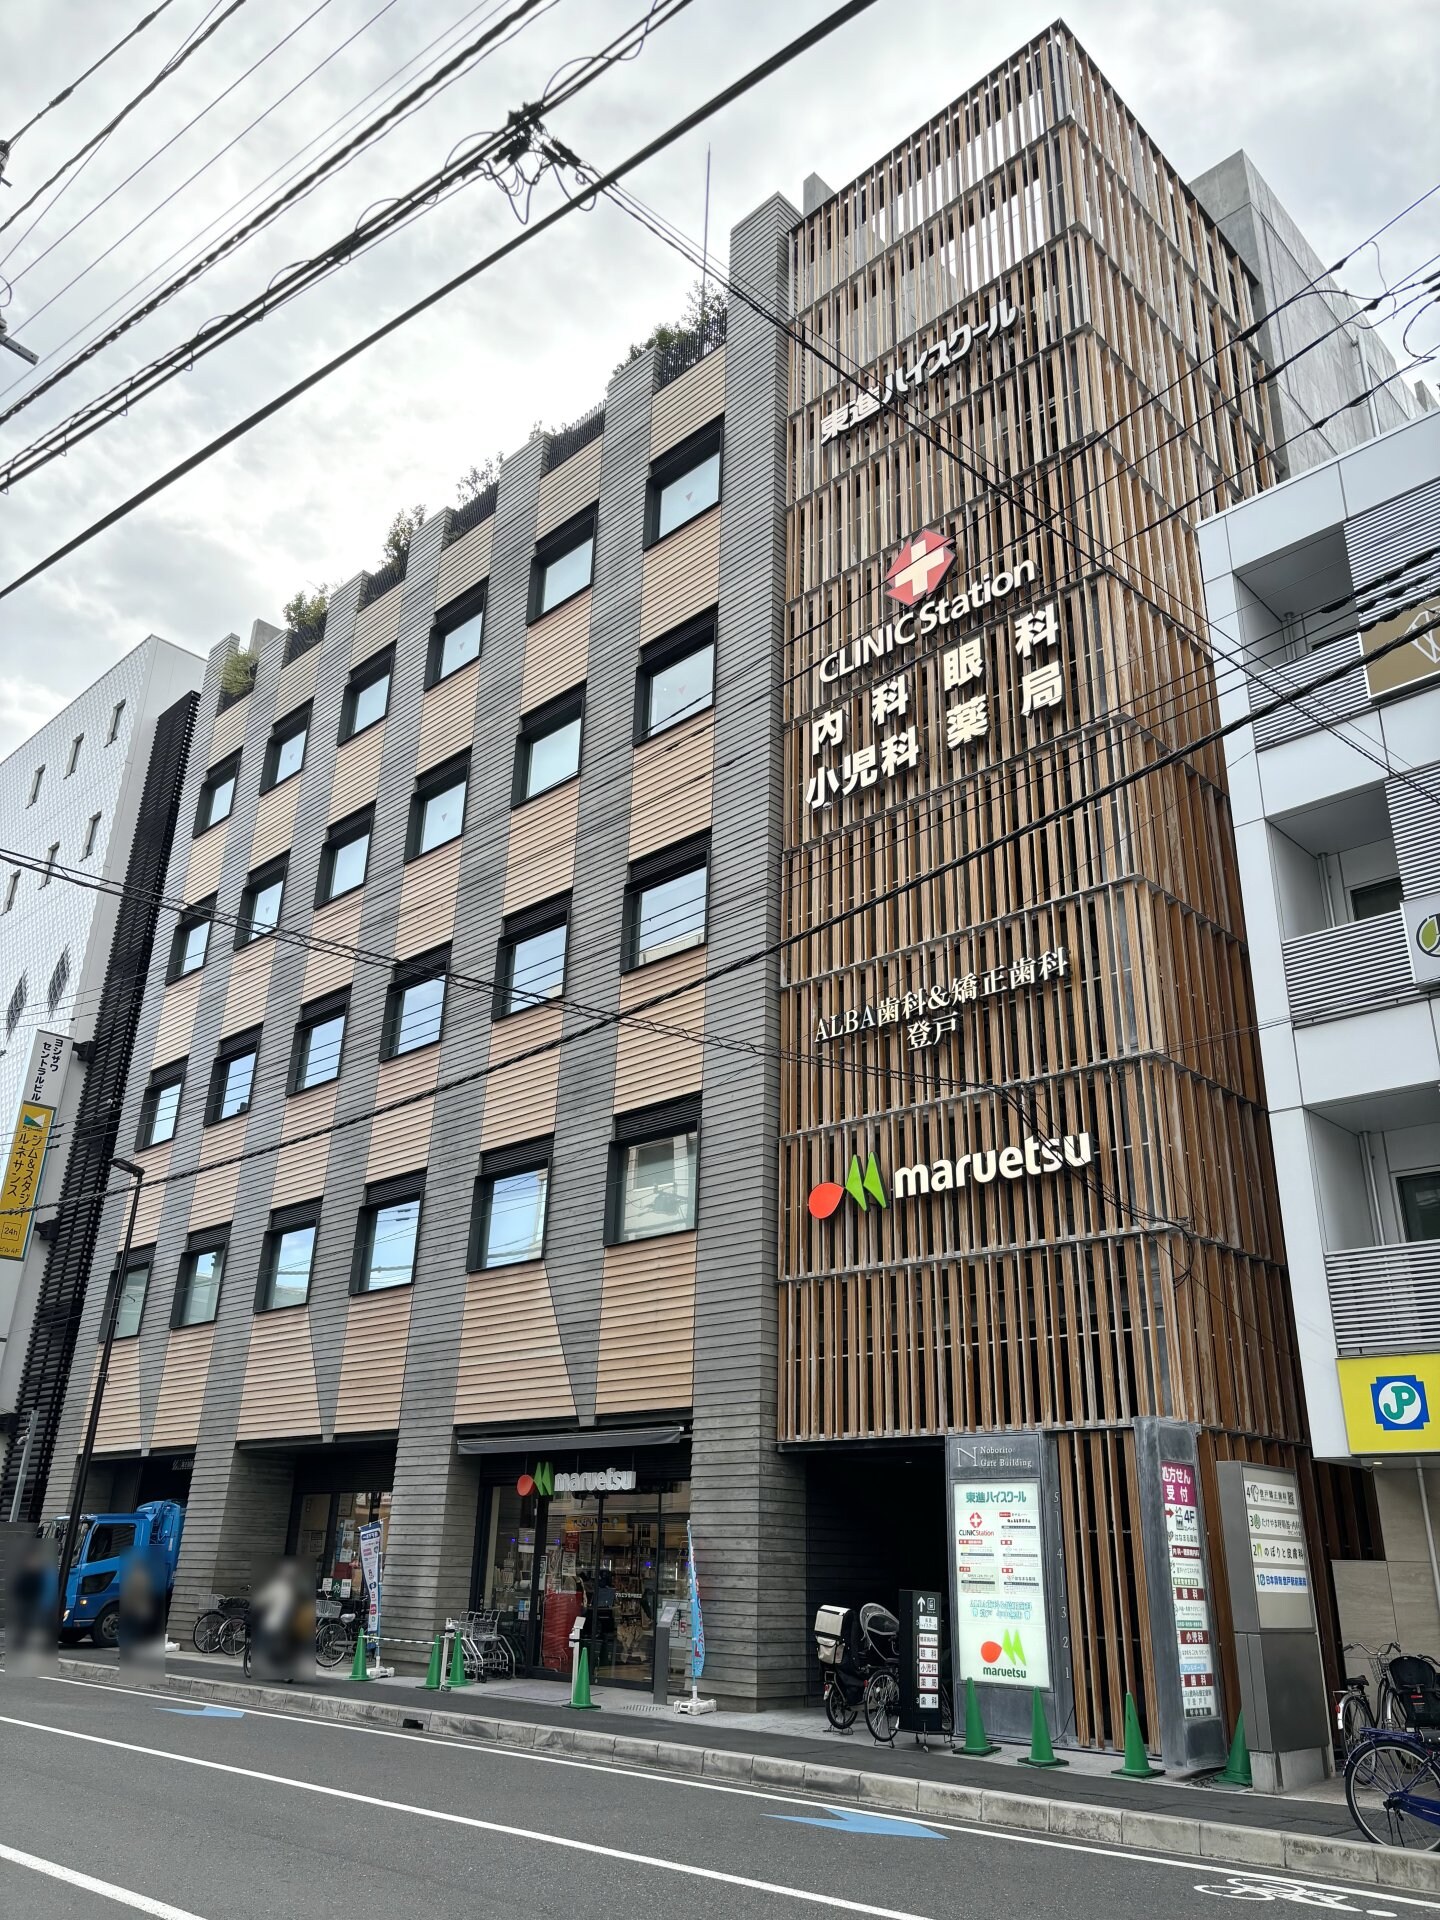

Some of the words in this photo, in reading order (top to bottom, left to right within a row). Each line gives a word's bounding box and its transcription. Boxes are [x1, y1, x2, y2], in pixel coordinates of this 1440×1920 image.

[820, 299, 1018, 446] 東進ハイスクール
[805, 725, 921, 810] 小児科
[906, 1010, 960, 1051] 登戸
[49, 1038, 64, 1072] ヨシザワ
[31, 1041, 52, 1102] セントラルビル
[7, 1132, 29, 1197] ルネサンス
[894, 1131, 1093, 1199] maruetsu
[4, 1226, 18, 1237] 24h
[980, 1458, 997, 1467] Gate
[1000, 1458, 1032, 1468] Building
[554, 1468, 637, 1492] maruetsu
[965, 1491, 1027, 1504] 東進ハイスクール
[1053, 1492, 1060, 1503] 5
[1184, 1509, 1195, 1524] 4F
[1056, 1548, 1063, 1560] 4
[1060, 1607, 1068, 1619] 3
[1062, 1636, 1069, 1648] 2
[920, 1664, 937, 1673] 小児科
[983, 1666, 1027, 1679] maruetsu
[1065, 1666, 1070, 1678] 1
